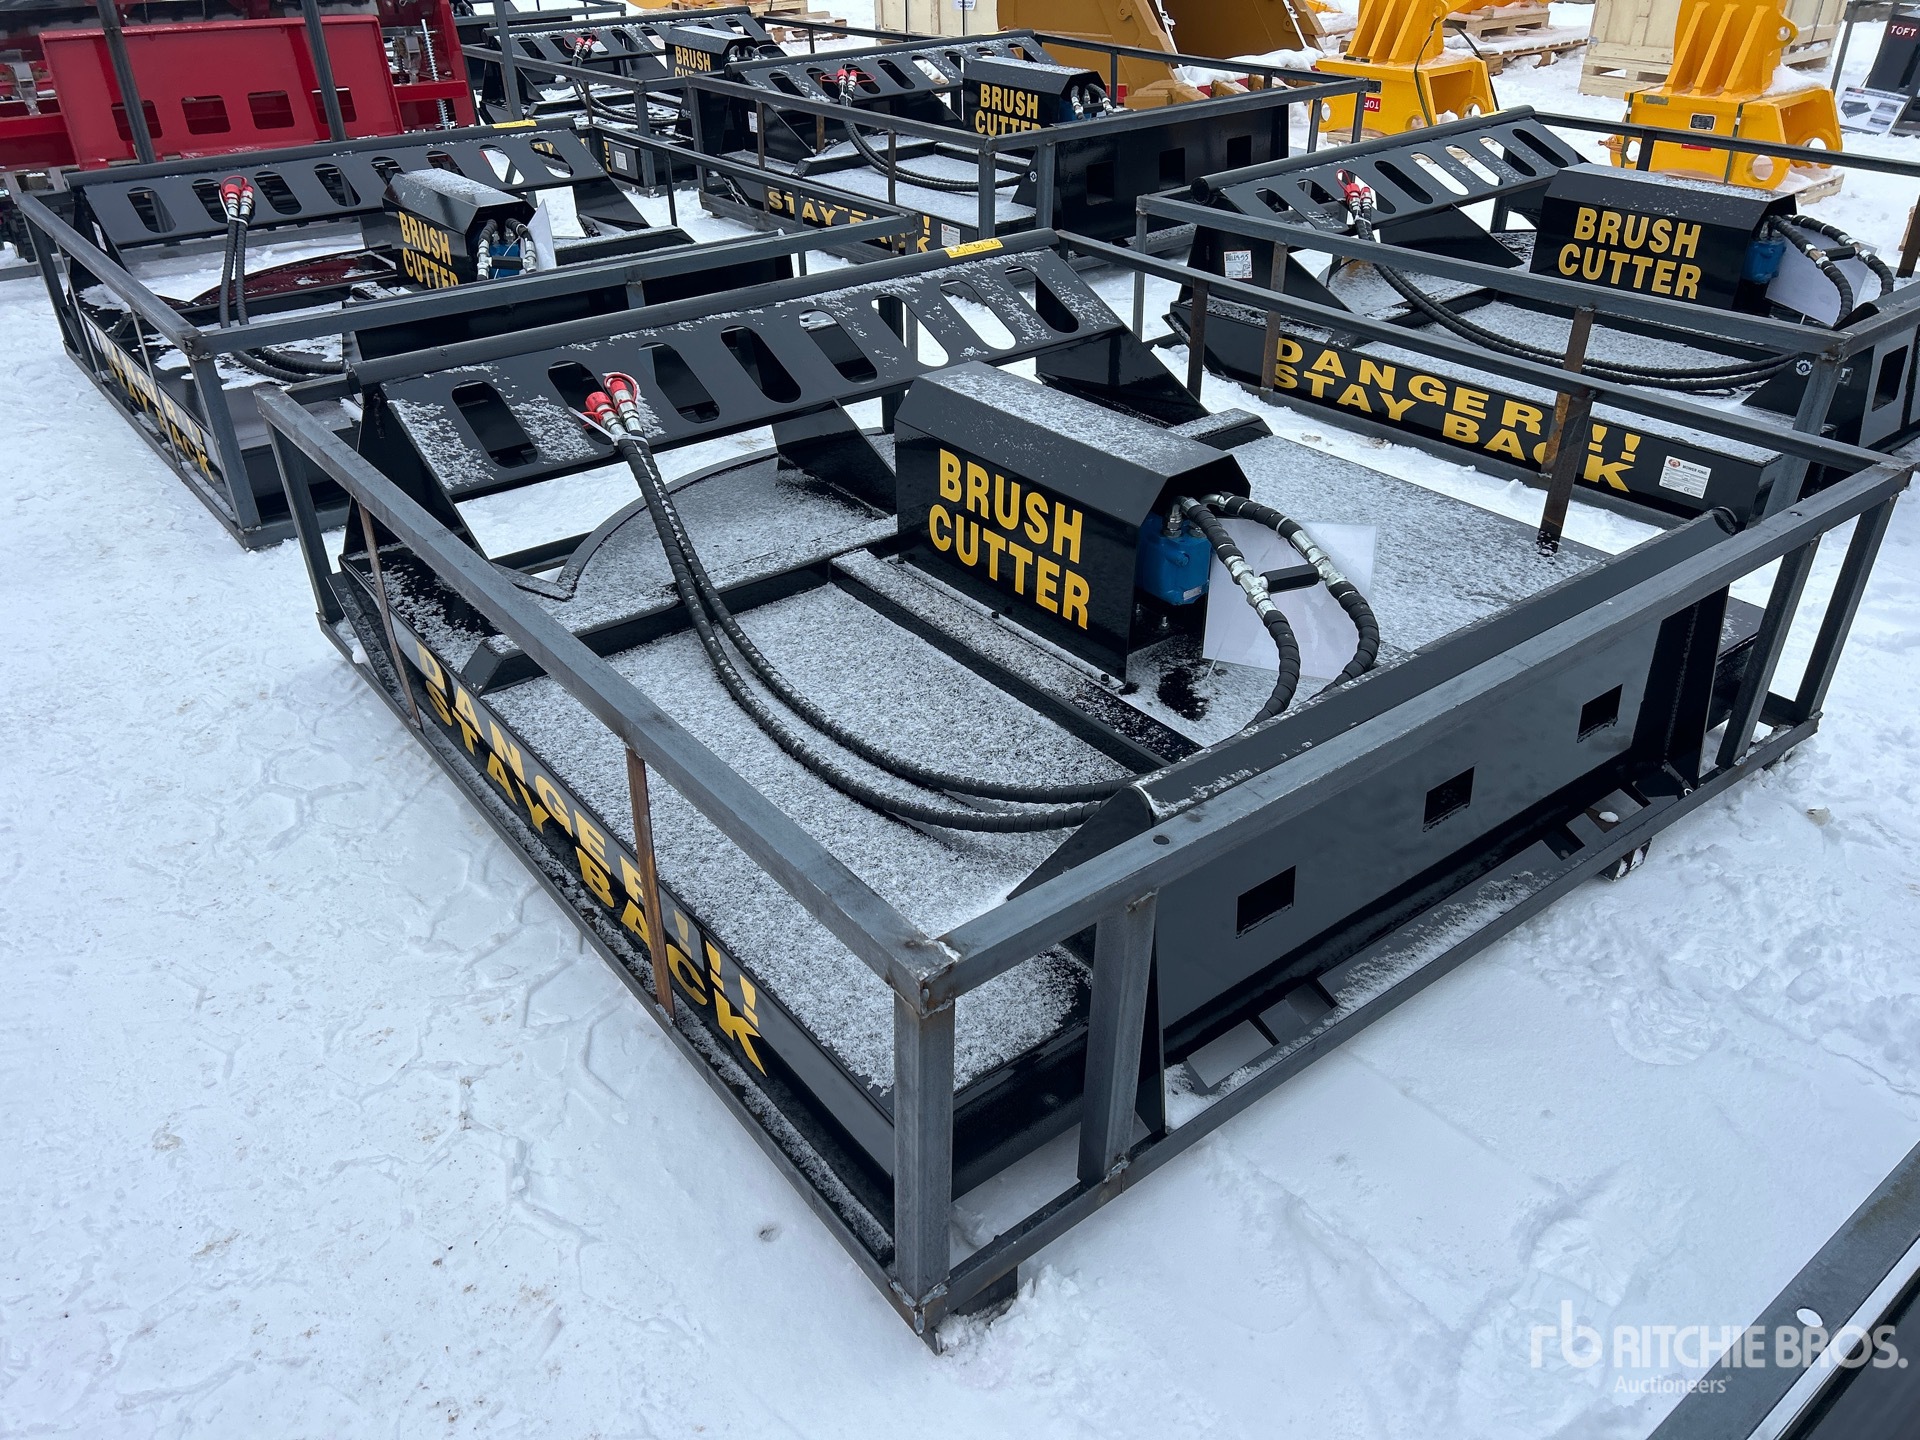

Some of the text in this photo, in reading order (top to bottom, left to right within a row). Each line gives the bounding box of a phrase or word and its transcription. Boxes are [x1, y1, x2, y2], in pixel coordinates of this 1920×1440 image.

[674, 45, 711, 72] BRUSH
[1890, 25, 1917, 37] TOFT
[980, 83, 1039, 119] BRUSH
[1363, 99, 1379, 110] TOF
[398, 211, 453, 267] BRUSH
[1573, 206, 1702, 259] BRUSH
[1558, 243, 1702, 300] CUTTER
[1274, 363, 1417, 421] STAY
[939, 448, 1083, 564] BRUSH
[928, 503, 1091, 631] CUTTER
[424, 679, 768, 1078] STAY BACK
